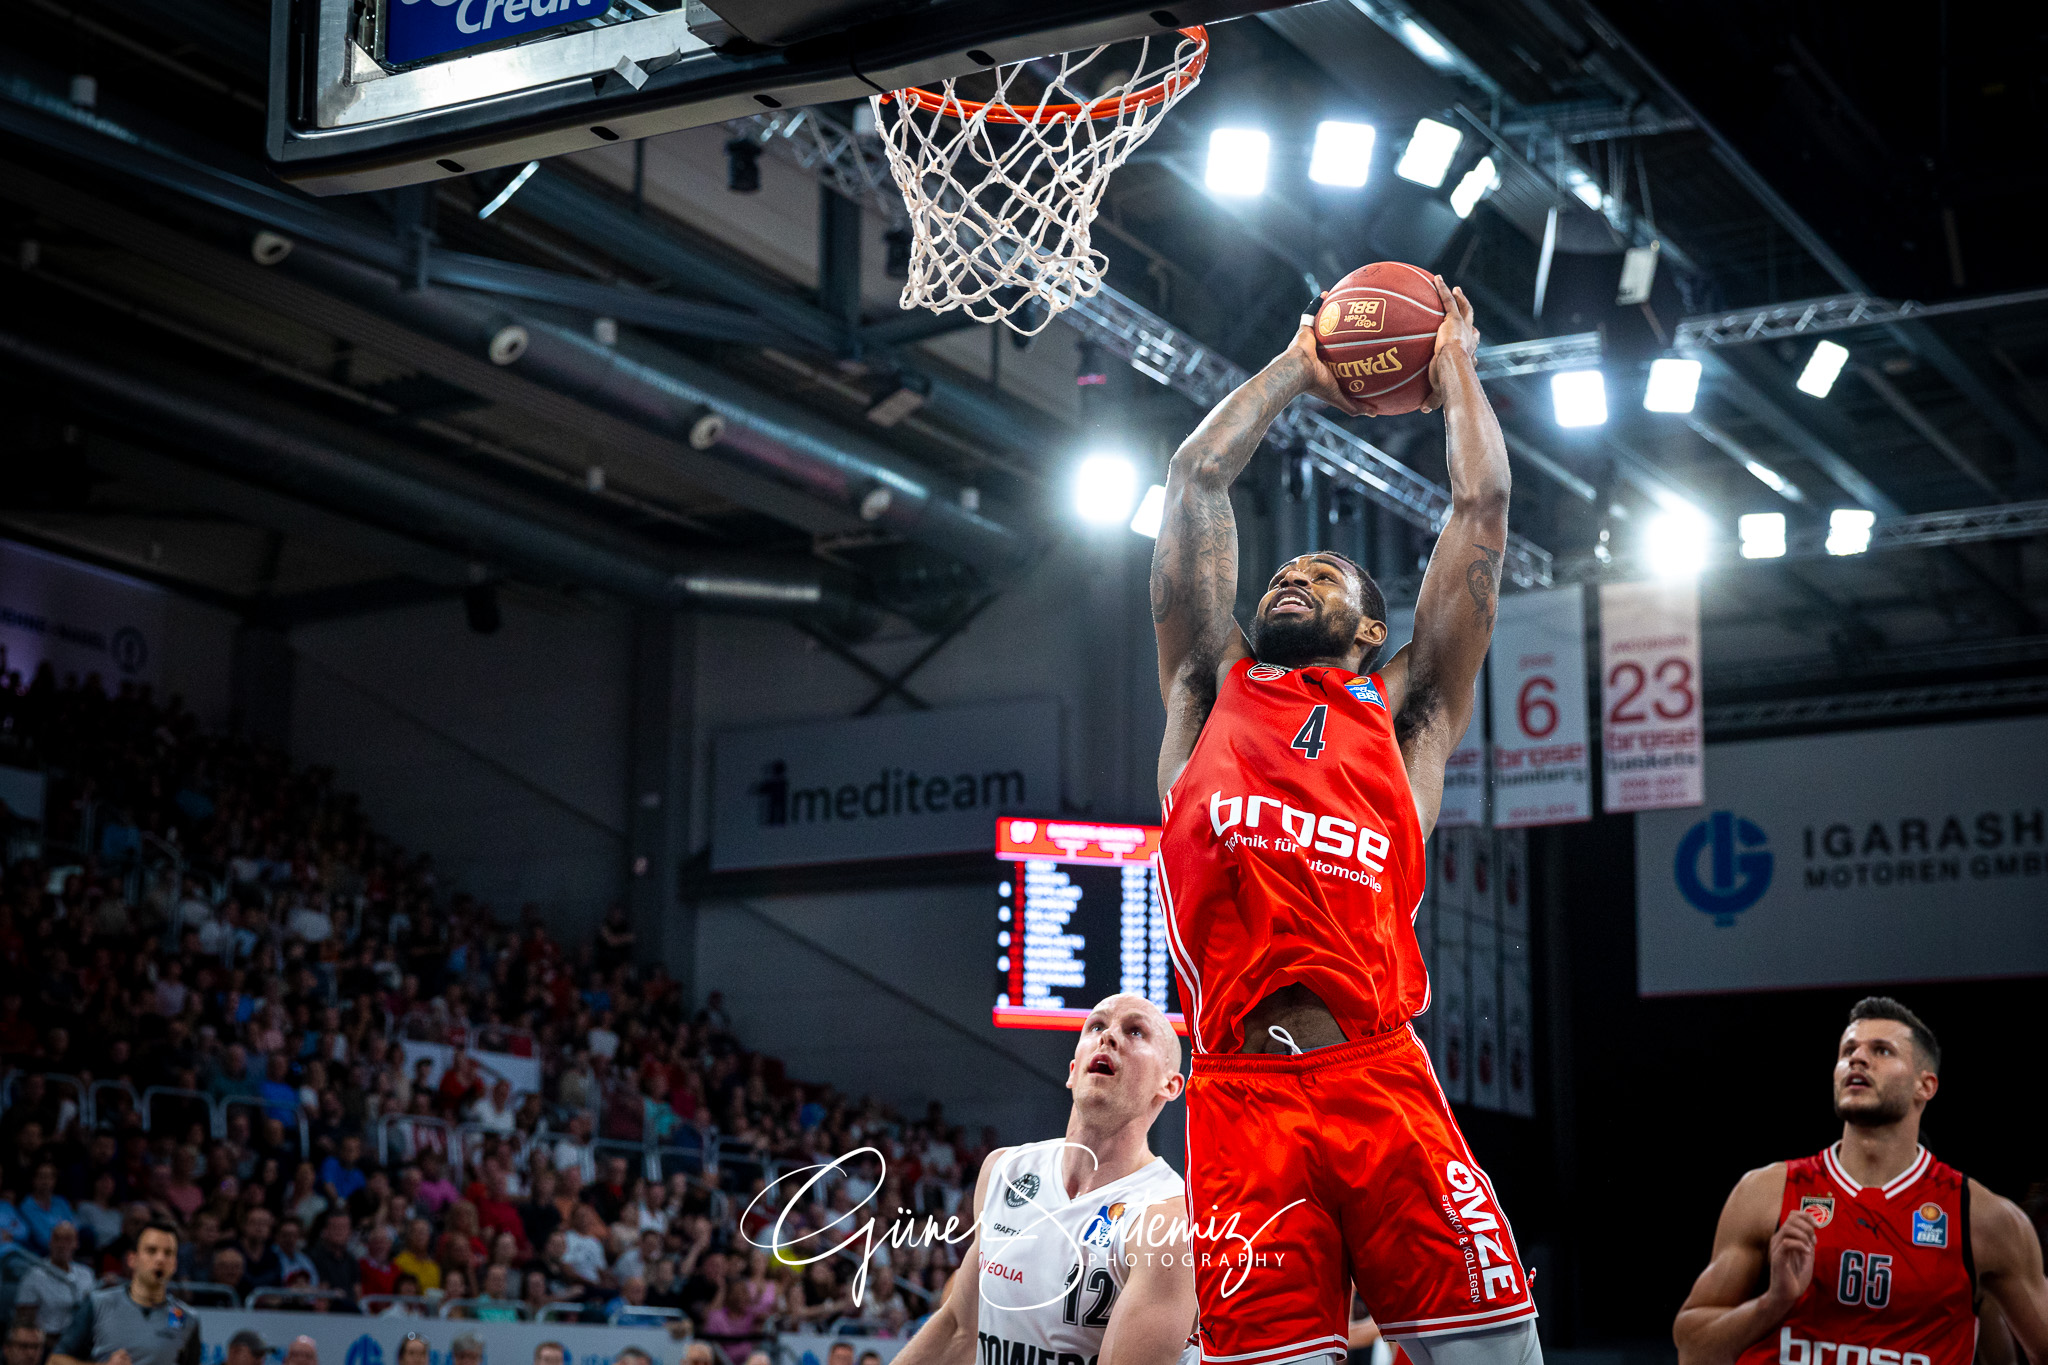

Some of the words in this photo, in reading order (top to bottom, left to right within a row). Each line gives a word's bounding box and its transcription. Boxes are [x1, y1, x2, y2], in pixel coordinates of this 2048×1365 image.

[456, 0, 592, 34] Cred
[1347, 301, 1380, 314] BBL
[1323, 346, 1402, 378] SPALDI
[1516, 674, 1559, 740] 6
[1609, 656, 1695, 723] 23
[1290, 704, 1329, 760] 4
[1210, 790, 1390, 873] brose
[1803, 807, 2046, 861] IGARASH
[1224, 831, 1269, 853] Tchnik
[1274, 837, 1299, 853] für
[1304, 857, 1382, 893] utomobile
[1803, 856, 1961, 890] MOTOREN
[1968, 850, 2048, 881] GMB
[1458, 1236, 1469, 1246] &
[983, 1259, 1023, 1284] VEOLIA
[1062, 1263, 1118, 1329] 12
[1462, 1246, 1481, 1304] KOLLEGEN
[1837, 1249, 1893, 1309] 65
